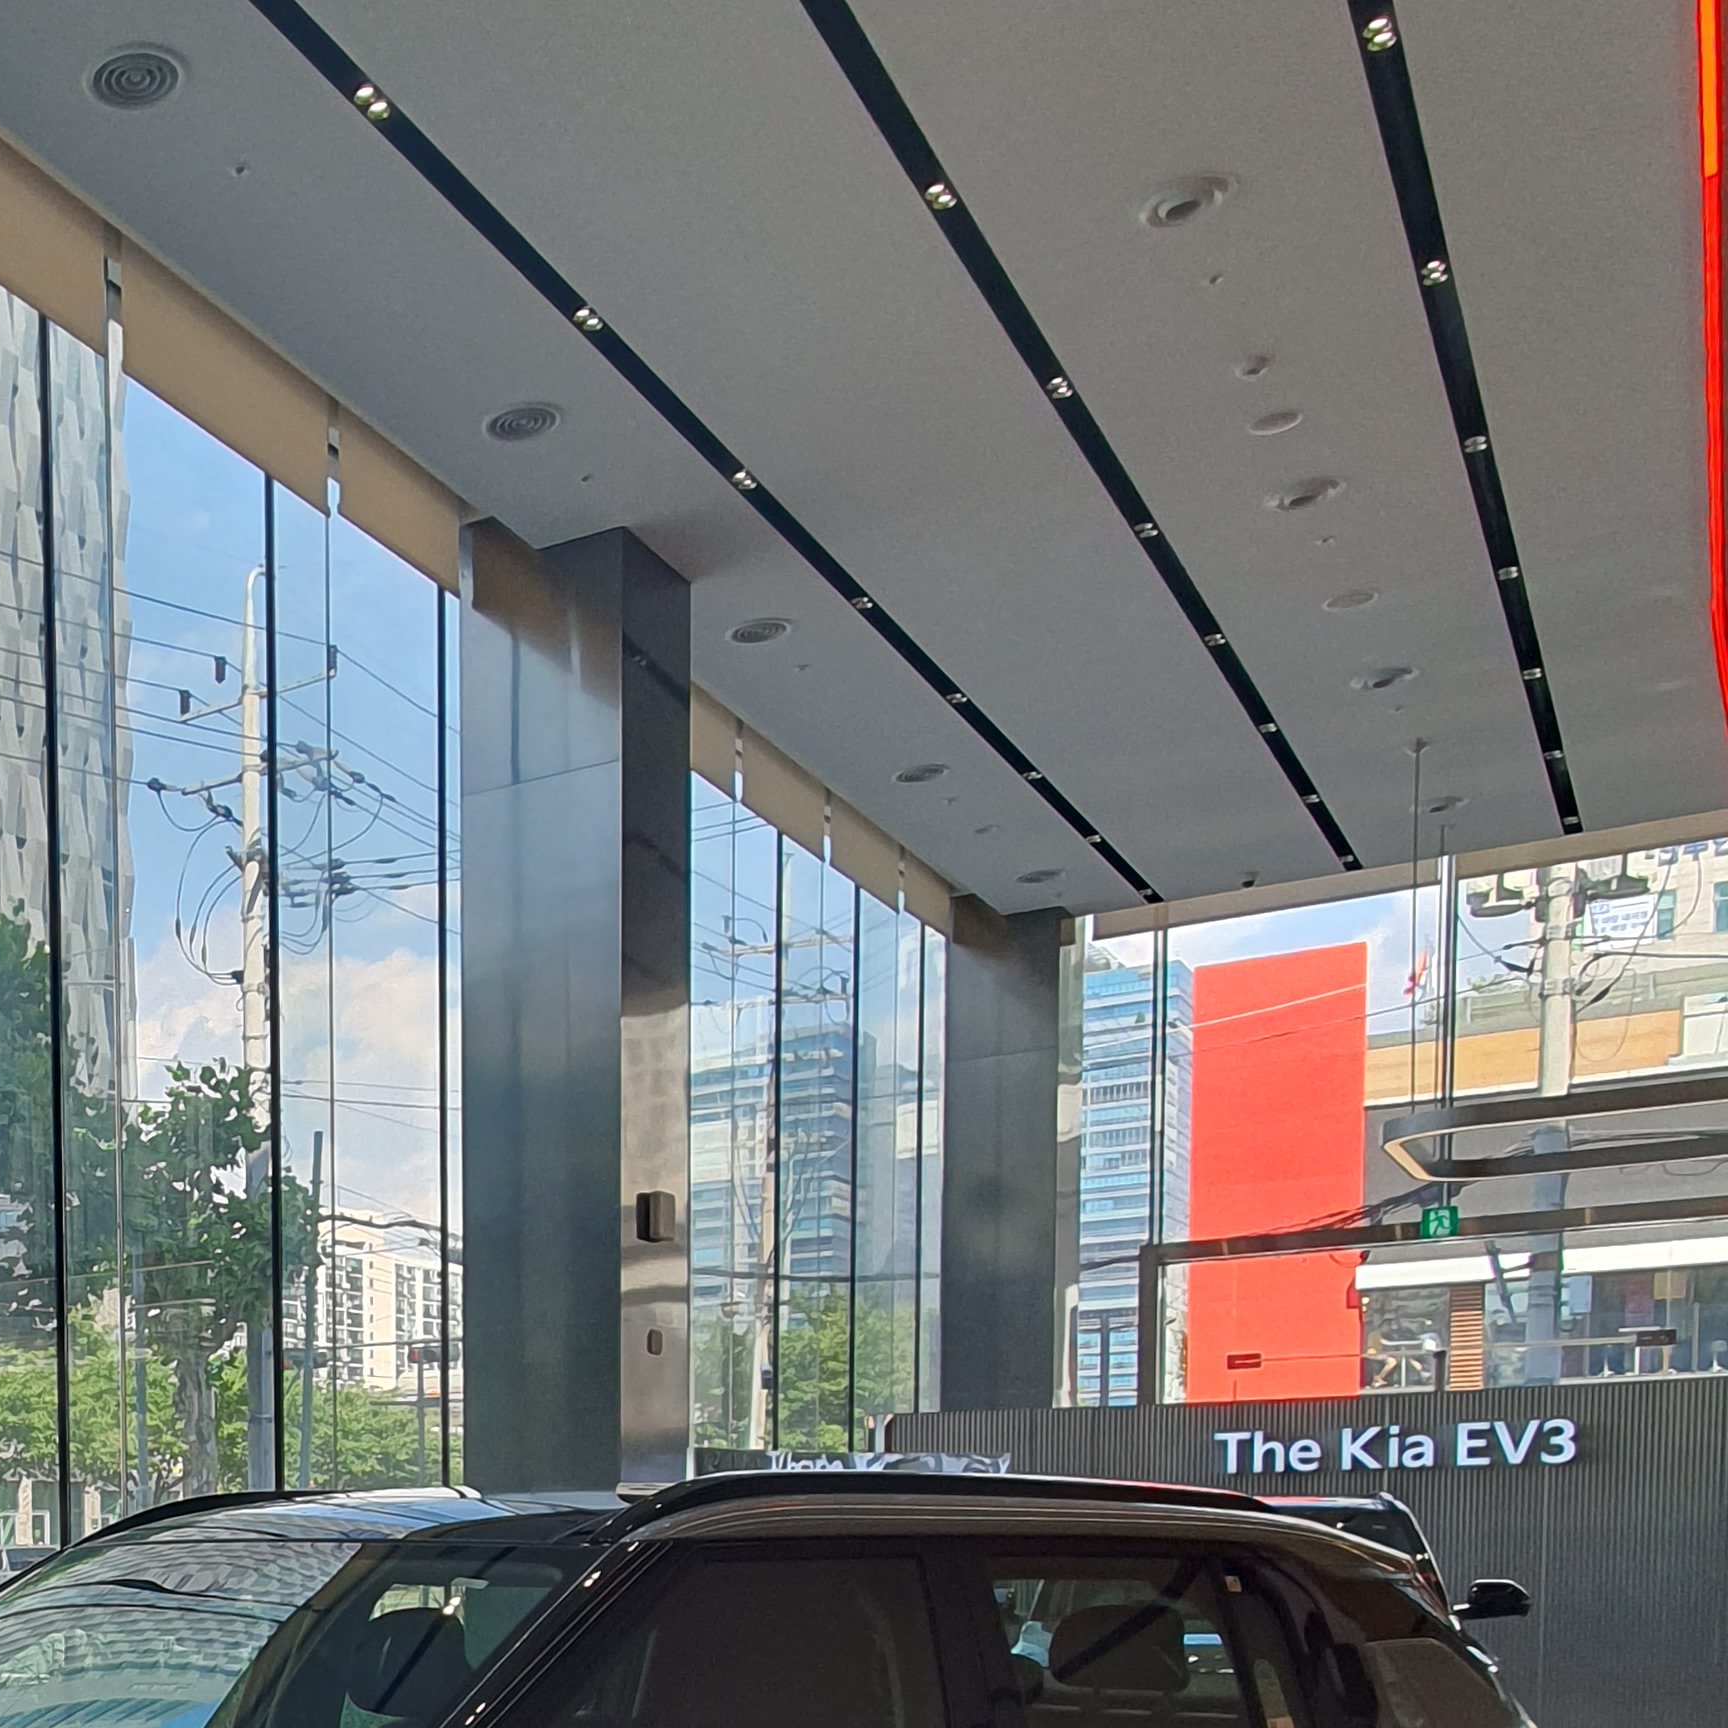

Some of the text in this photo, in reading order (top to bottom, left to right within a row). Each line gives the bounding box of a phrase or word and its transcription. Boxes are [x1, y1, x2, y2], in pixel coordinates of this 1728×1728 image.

[1213, 1418, 1577, 1475] The Kia EV3
